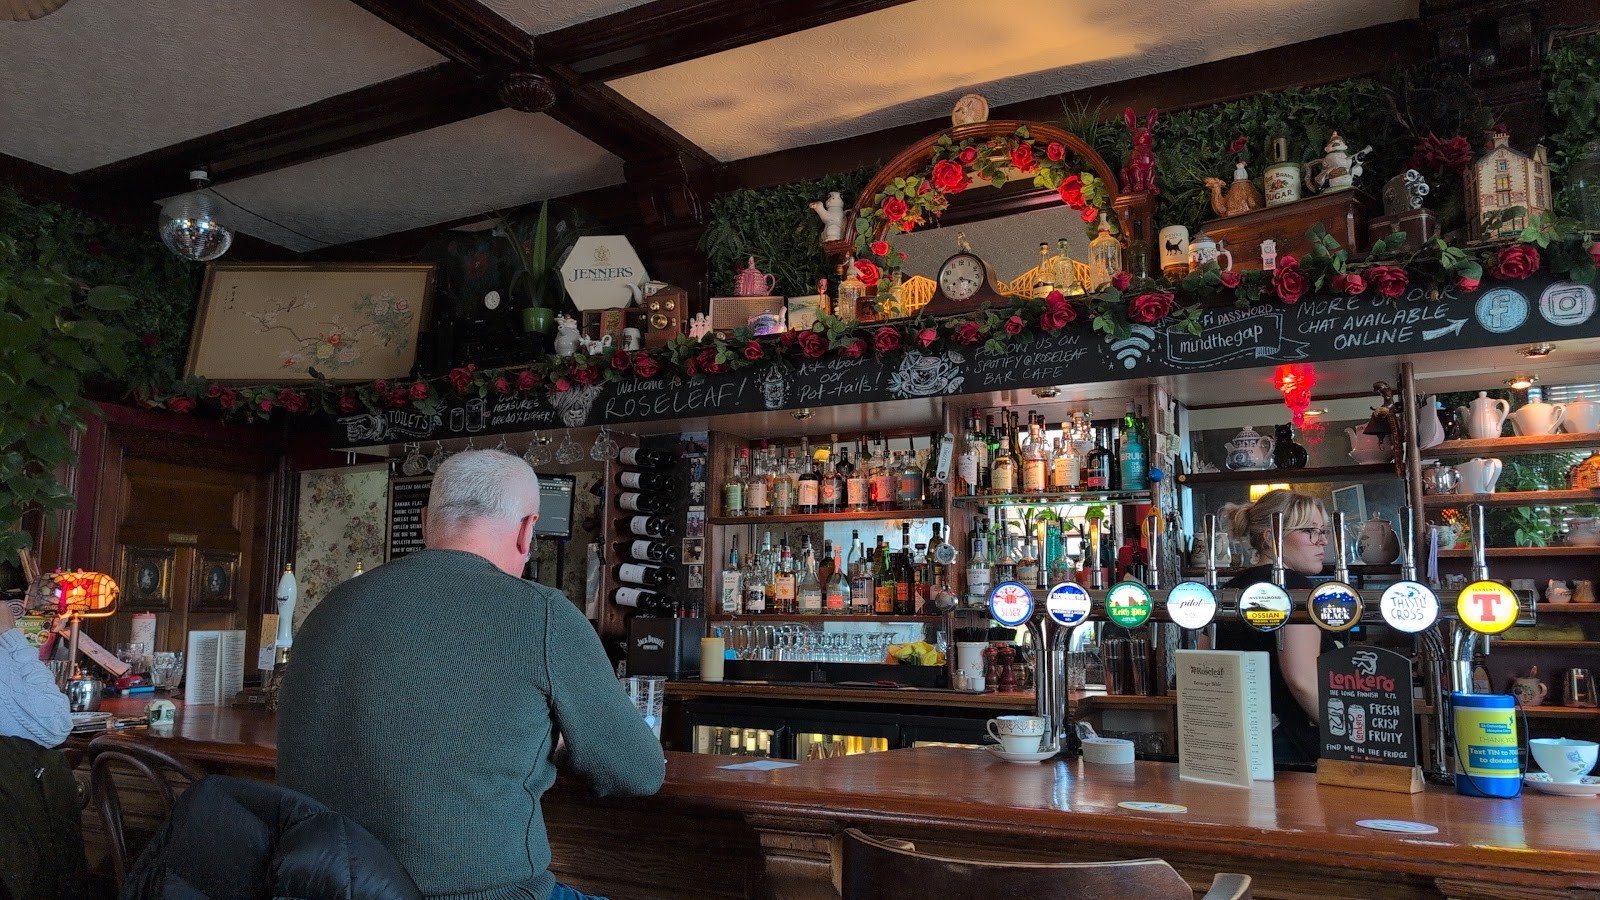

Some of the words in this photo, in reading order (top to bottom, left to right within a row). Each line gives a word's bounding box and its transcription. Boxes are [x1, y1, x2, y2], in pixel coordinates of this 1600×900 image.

[1266, 190, 1294, 201] SUGAR
[569, 266, 633, 282] JENNERS
[1297, 296, 1360, 318] MORE
[1298, 317, 1336, 334] CHAT
[1343, 303, 1450, 330] AVAILABLE
[1035, 337, 1053, 350] US
[1058, 335, 1080, 347] ON
[1180, 325, 1263, 353] mindthegap
[1334, 329, 1414, 350] ONLINE
[799, 362, 825, 376] Ask
[828, 356, 871, 370] about
[983, 370, 1017, 385] BAR
[616, 378, 664, 395] Welcome
[493, 399, 539, 413] MEASURES
[605, 377, 747, 419] ROSELEAF!
[388, 411, 429, 429] TOILETS
[1180, 598, 1203, 608] pilot
[1390, 594, 1426, 608] THISTLY
[1472, 594, 1501, 621] T
[1321, 612, 1350, 620] BLACK
[1391, 608, 1424, 620] CROSS
[1328, 670, 1395, 692] Lonkero
[1369, 703, 1400, 716] FRESH
[1372, 717, 1399, 730] CRISP
[1368, 730, 1403, 744] FRUITY
[1326, 743, 1341, 751] FIND
[1344, 744, 1355, 752] ME
[1368, 748, 1380, 756] THE
[1383, 750, 1408, 759] FRIDGE
